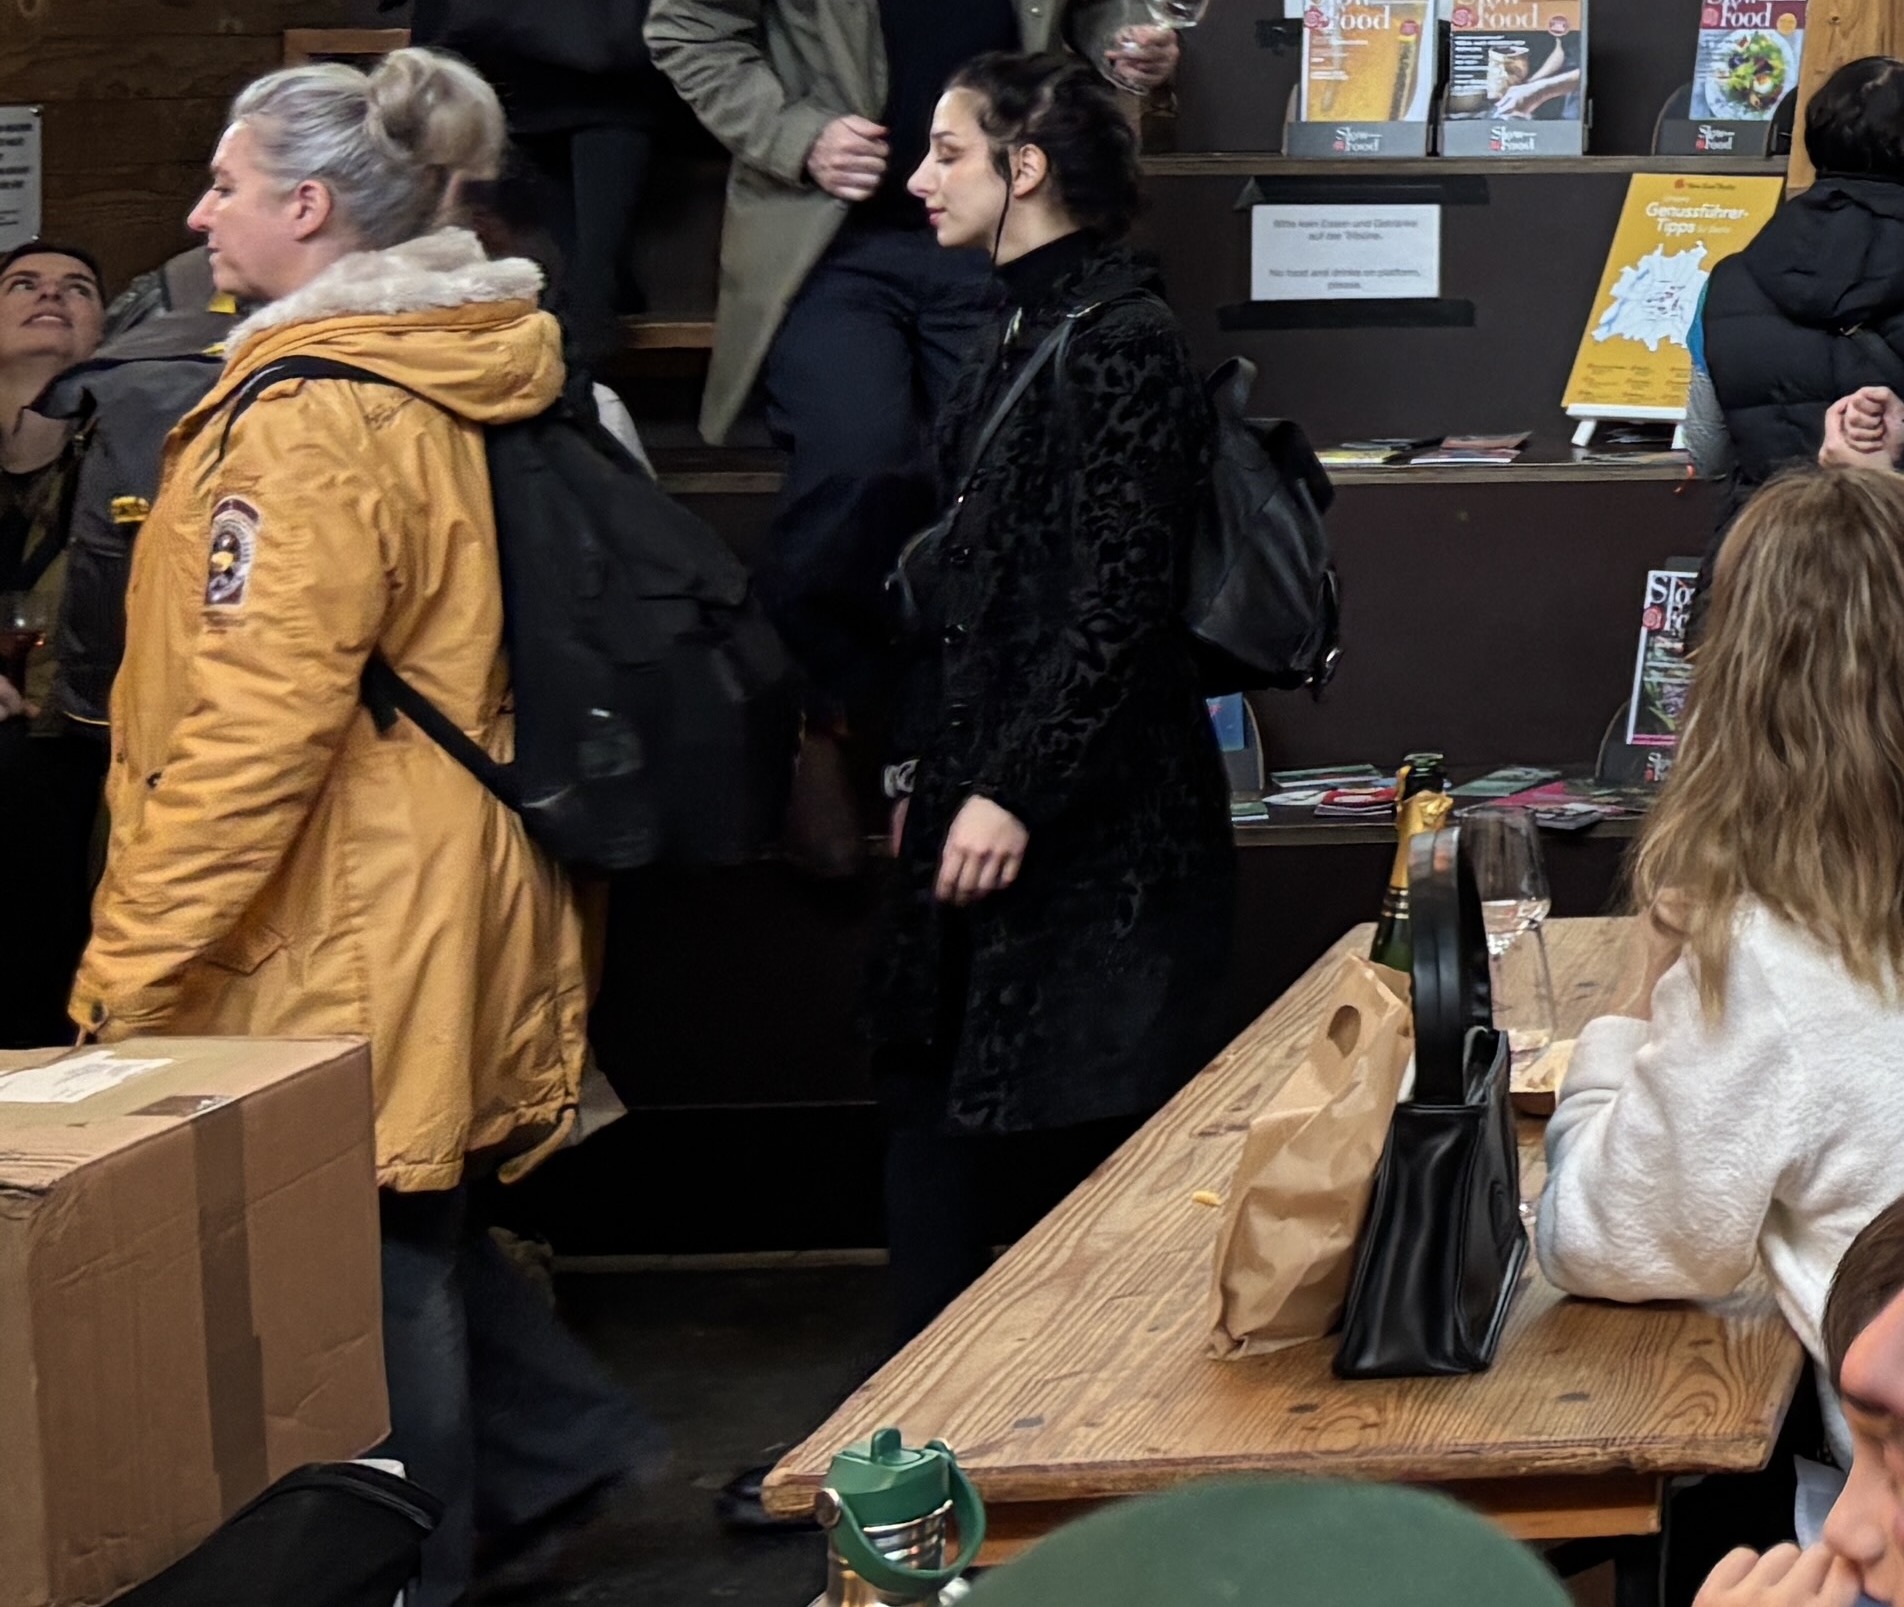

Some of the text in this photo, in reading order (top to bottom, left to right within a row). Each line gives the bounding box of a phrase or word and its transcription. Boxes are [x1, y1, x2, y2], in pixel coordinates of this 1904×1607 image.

[1477, 3, 1539, 29] Food
[1719, 2, 1773, 28] Food
[1650, 575, 1695, 604] Slo
